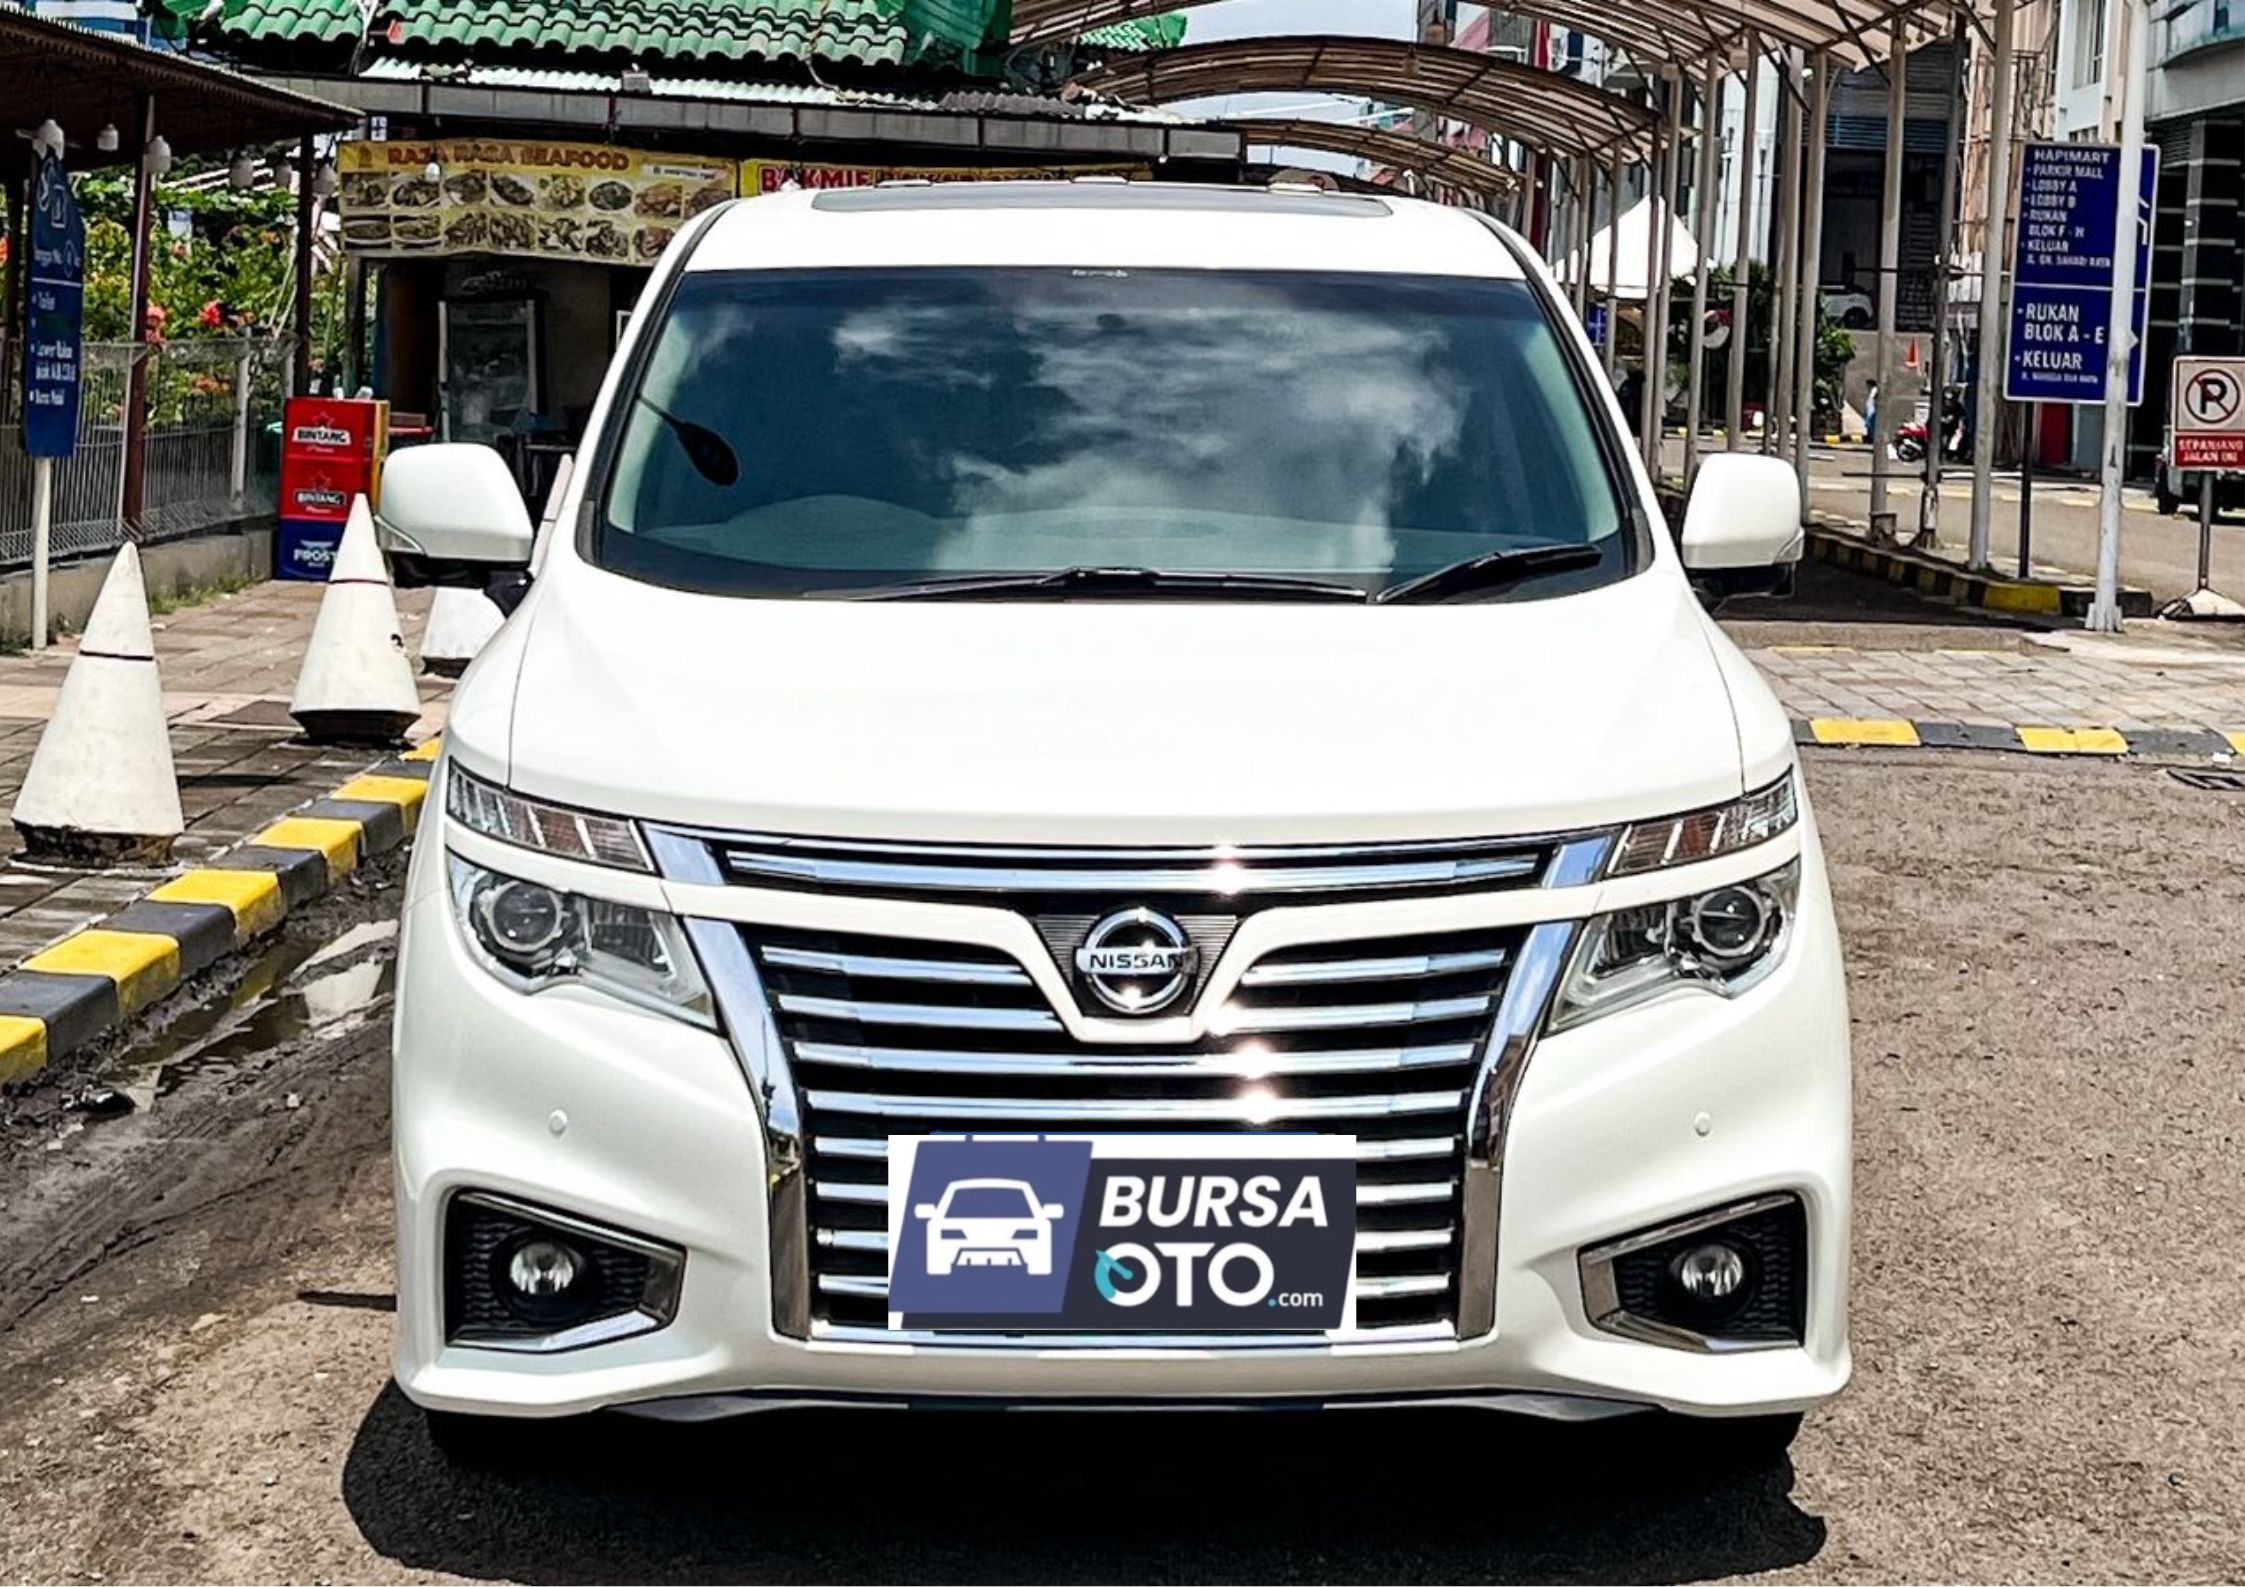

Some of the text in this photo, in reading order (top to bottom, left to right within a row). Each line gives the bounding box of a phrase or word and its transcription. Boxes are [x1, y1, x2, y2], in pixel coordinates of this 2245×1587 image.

[520, 147, 630, 170] SEAFOOD
[2034, 150, 2110, 164] HAPIMART
[2033, 163, 2103, 179] PARKIR MALL
[2068, 180, 2077, 192] A
[2027, 240, 2069, 252] KELUAR
[2026, 303, 2079, 322] RUKAN
[2024, 322, 2063, 341] BLOK
[2067, 324, 2079, 342] A
[2094, 326, 2105, 344] E
[2022, 350, 2082, 370] KELUAR
[298, 430, 346, 443] BINTANG
[2179, 440, 2244, 451] SEPANJANG
[297, 493, 341, 505] BINTANG
[1090, 954, 1183, 969] NISSAN
